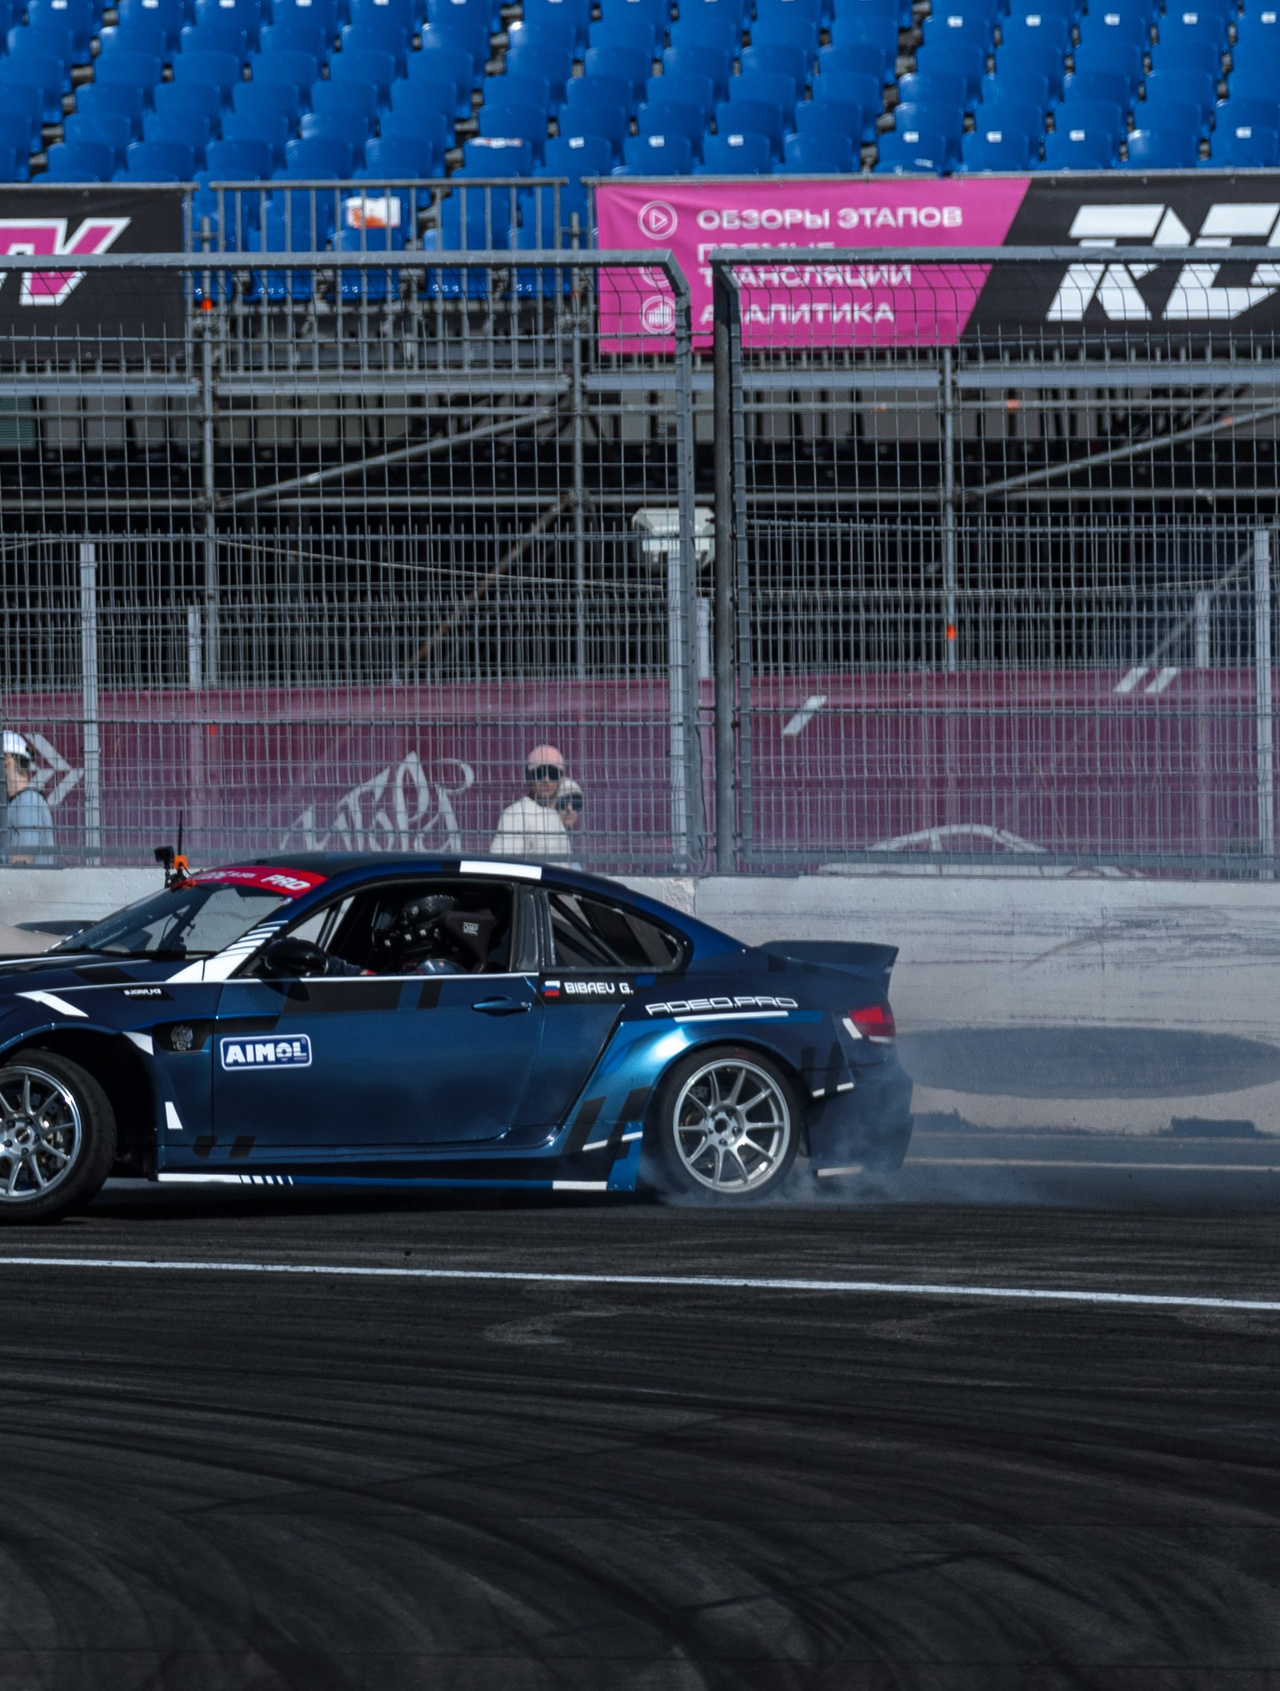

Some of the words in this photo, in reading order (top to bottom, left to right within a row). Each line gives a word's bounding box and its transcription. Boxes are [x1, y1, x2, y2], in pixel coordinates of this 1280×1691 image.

[696, 208, 831, 231] ОБЗОРЫ
[838, 205, 963, 229] ЭТАПОВ
[698, 265, 912, 289] ТАНСЛЯЦИИ
[699, 302, 895, 324] ААЛИТИКА
[564, 982, 616, 995] BIBAEV
[619, 982, 634, 995] G.
[225, 1041, 308, 1064] AIMOL
